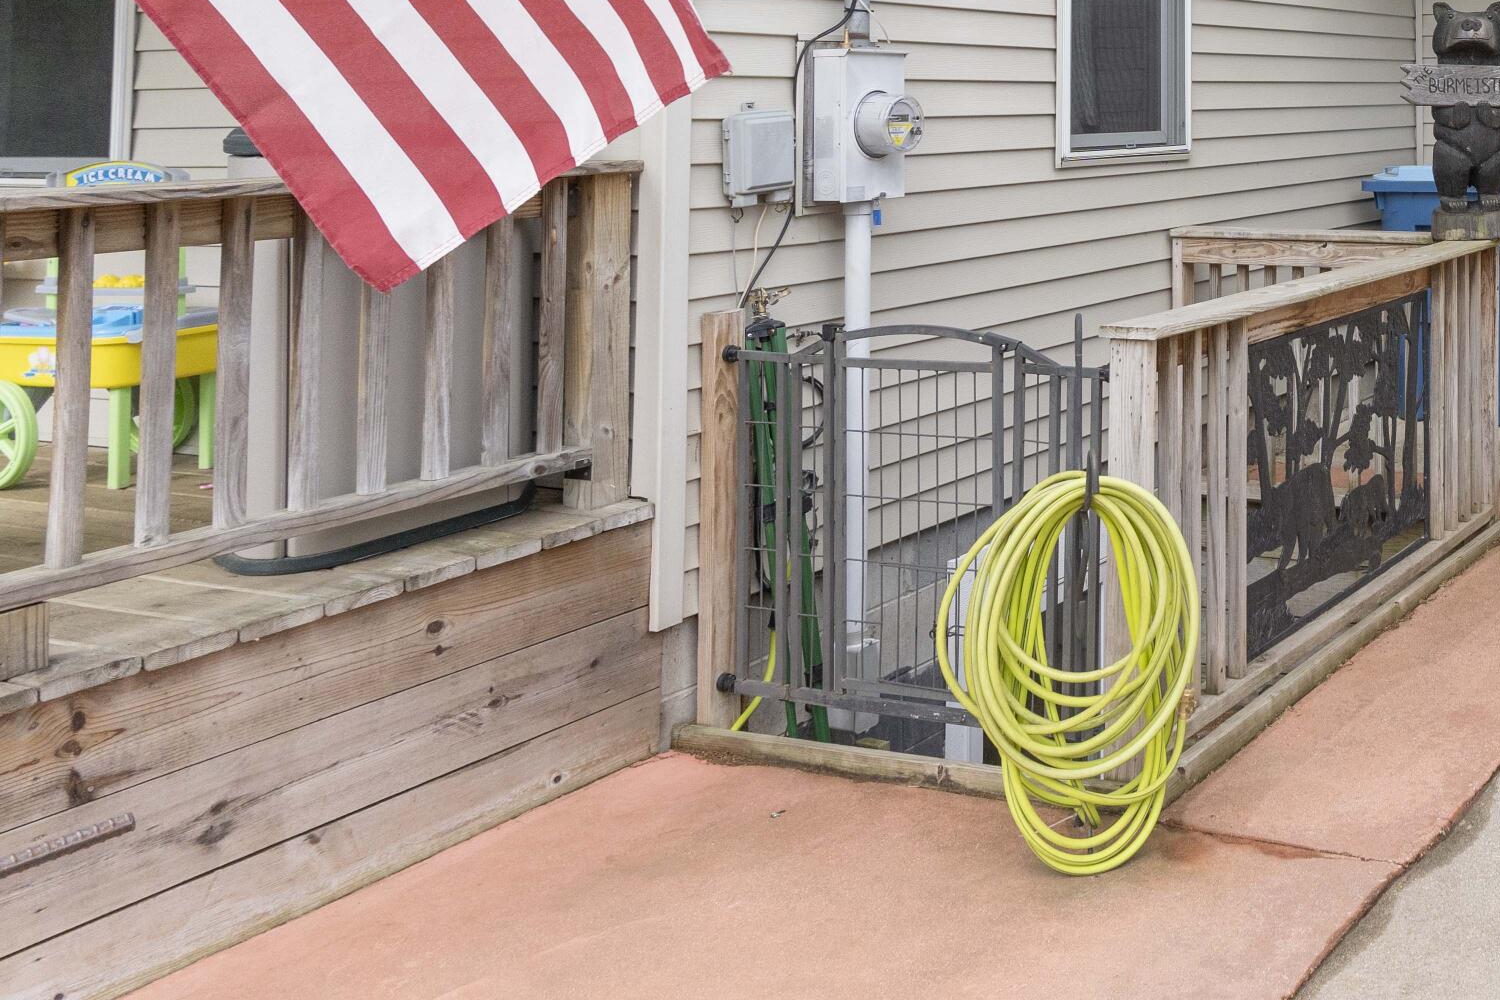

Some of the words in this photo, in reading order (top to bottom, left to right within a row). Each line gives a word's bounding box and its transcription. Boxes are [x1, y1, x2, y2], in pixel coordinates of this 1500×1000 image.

[1412, 65, 1433, 85] THE
[83, 170, 104, 184] ICE
[108, 167, 155, 183] CREAM
